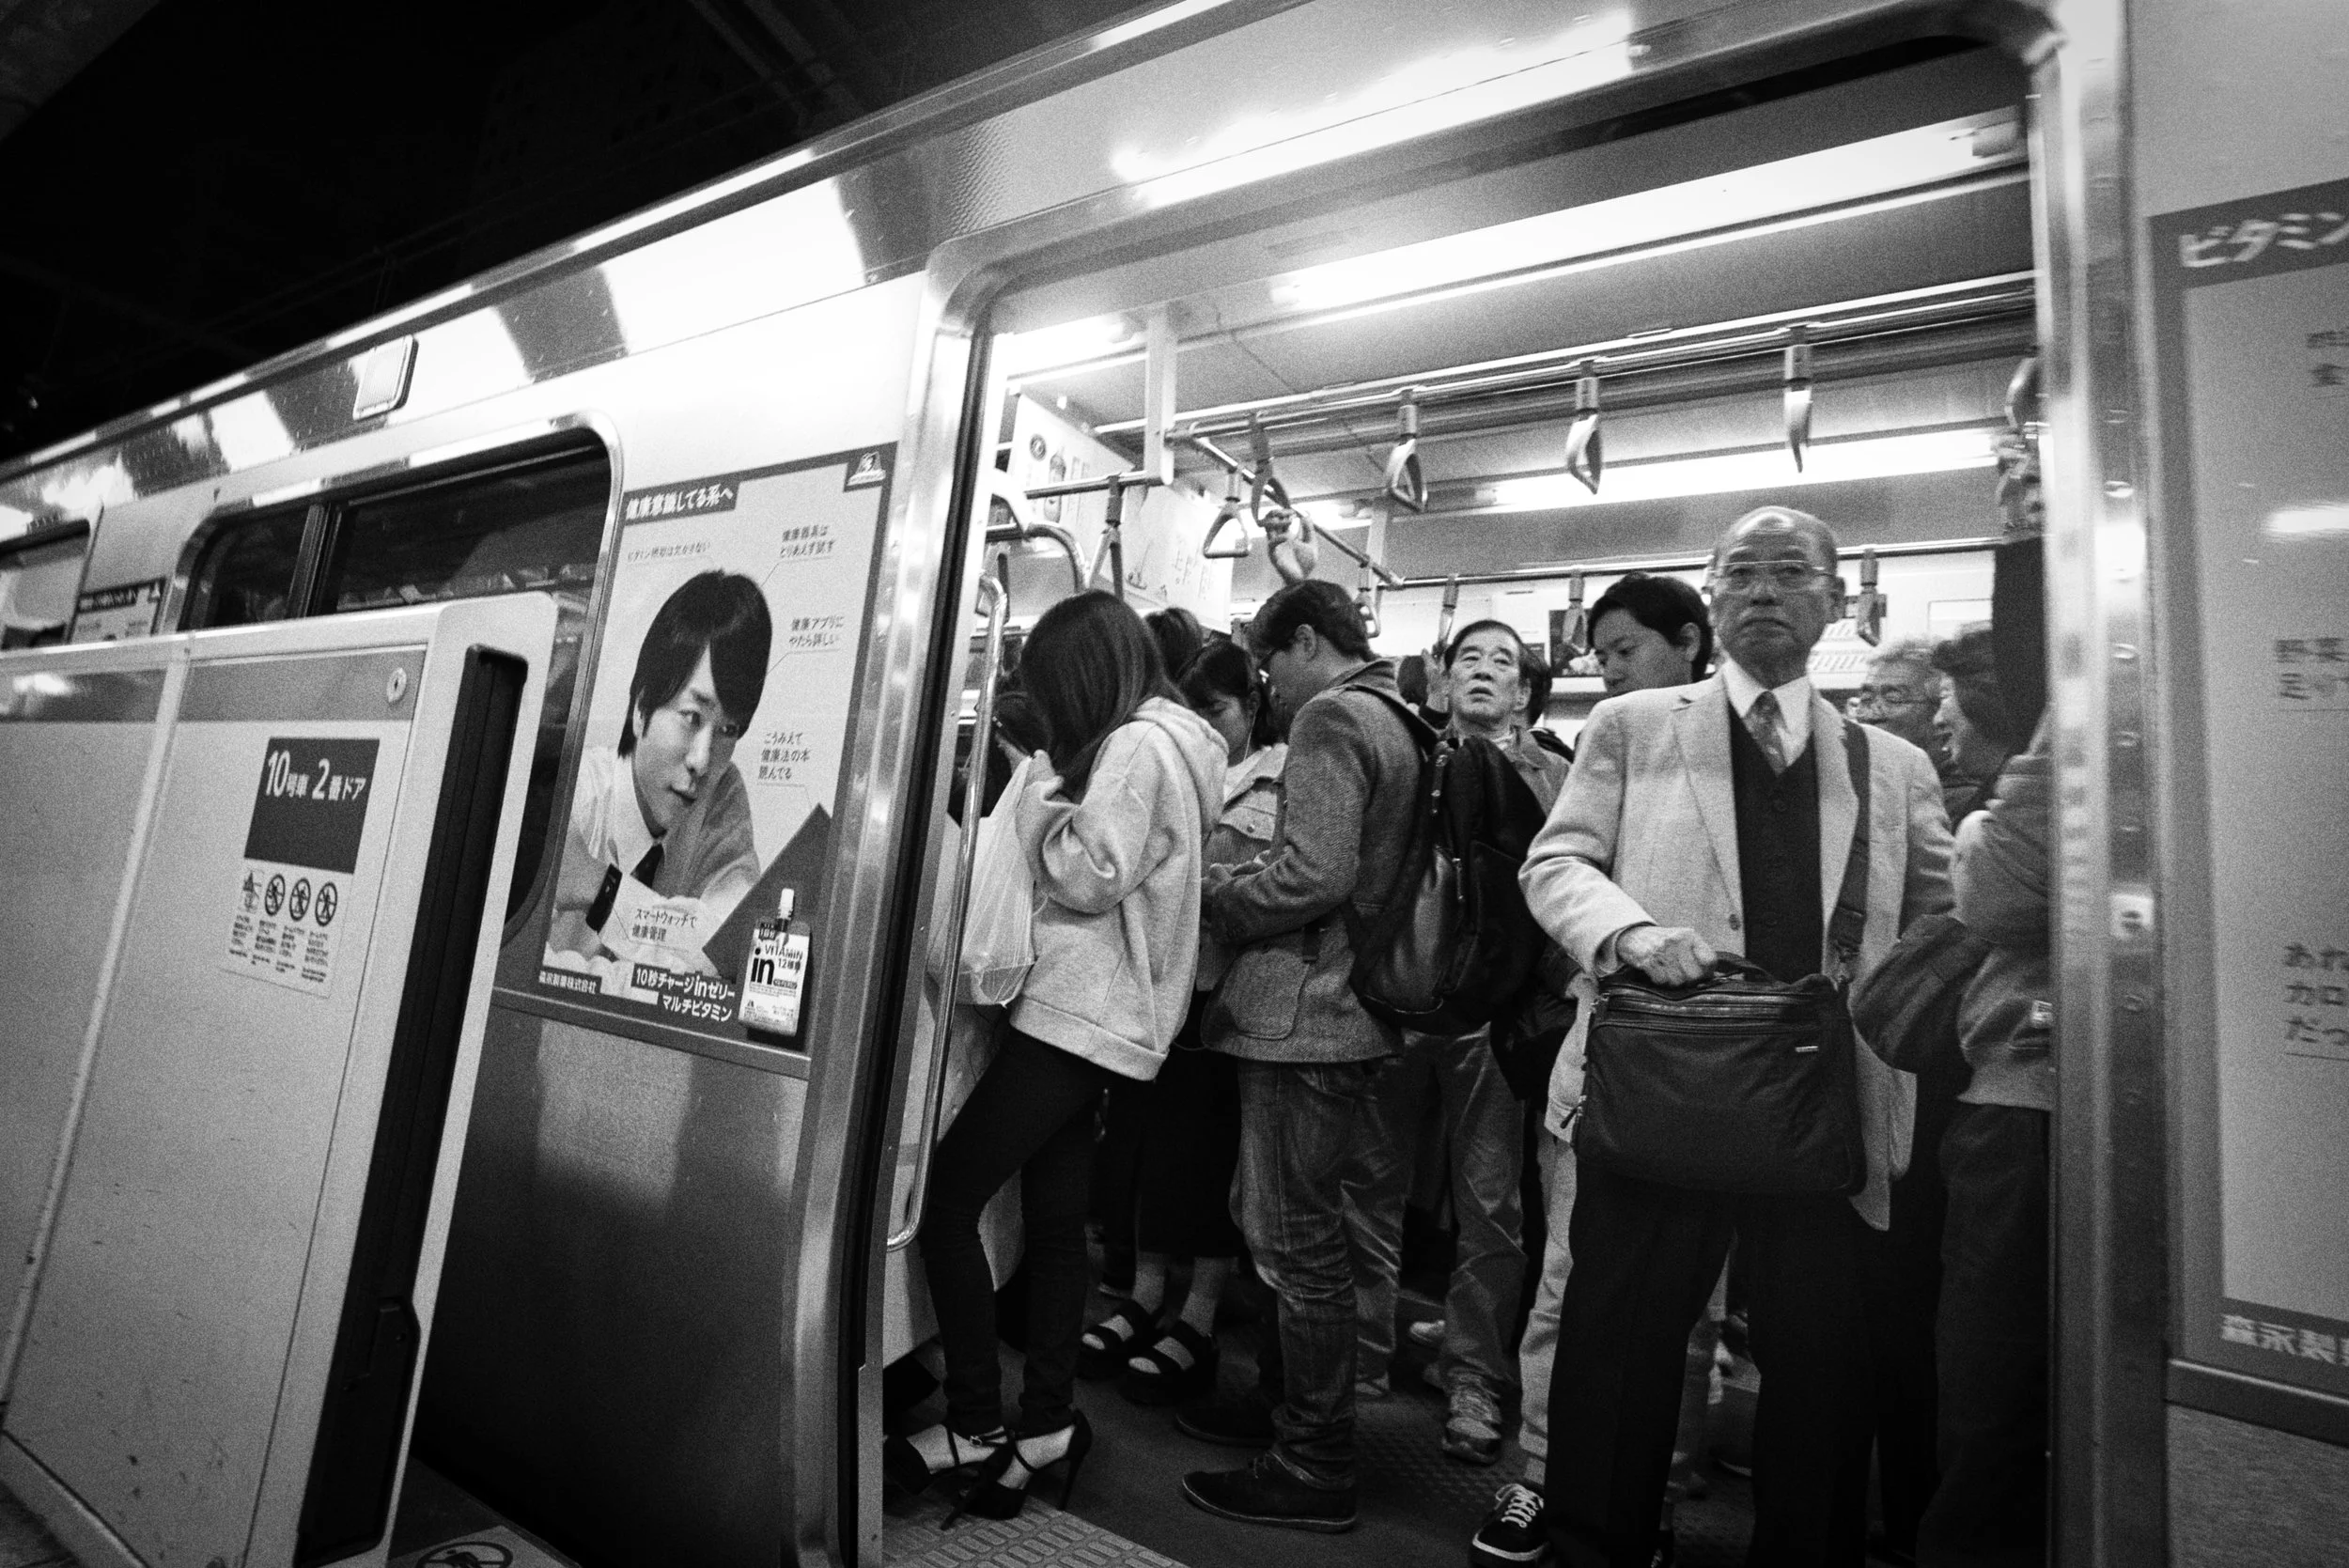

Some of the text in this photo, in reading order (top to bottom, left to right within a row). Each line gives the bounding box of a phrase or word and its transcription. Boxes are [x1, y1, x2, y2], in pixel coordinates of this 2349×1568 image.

[2177, 211, 2349, 268] ビタミン
[634, 908, 698, 929] スマートウォッチで
[751, 947, 775, 986] in
[661, 994, 733, 1022] マルチビタミン
